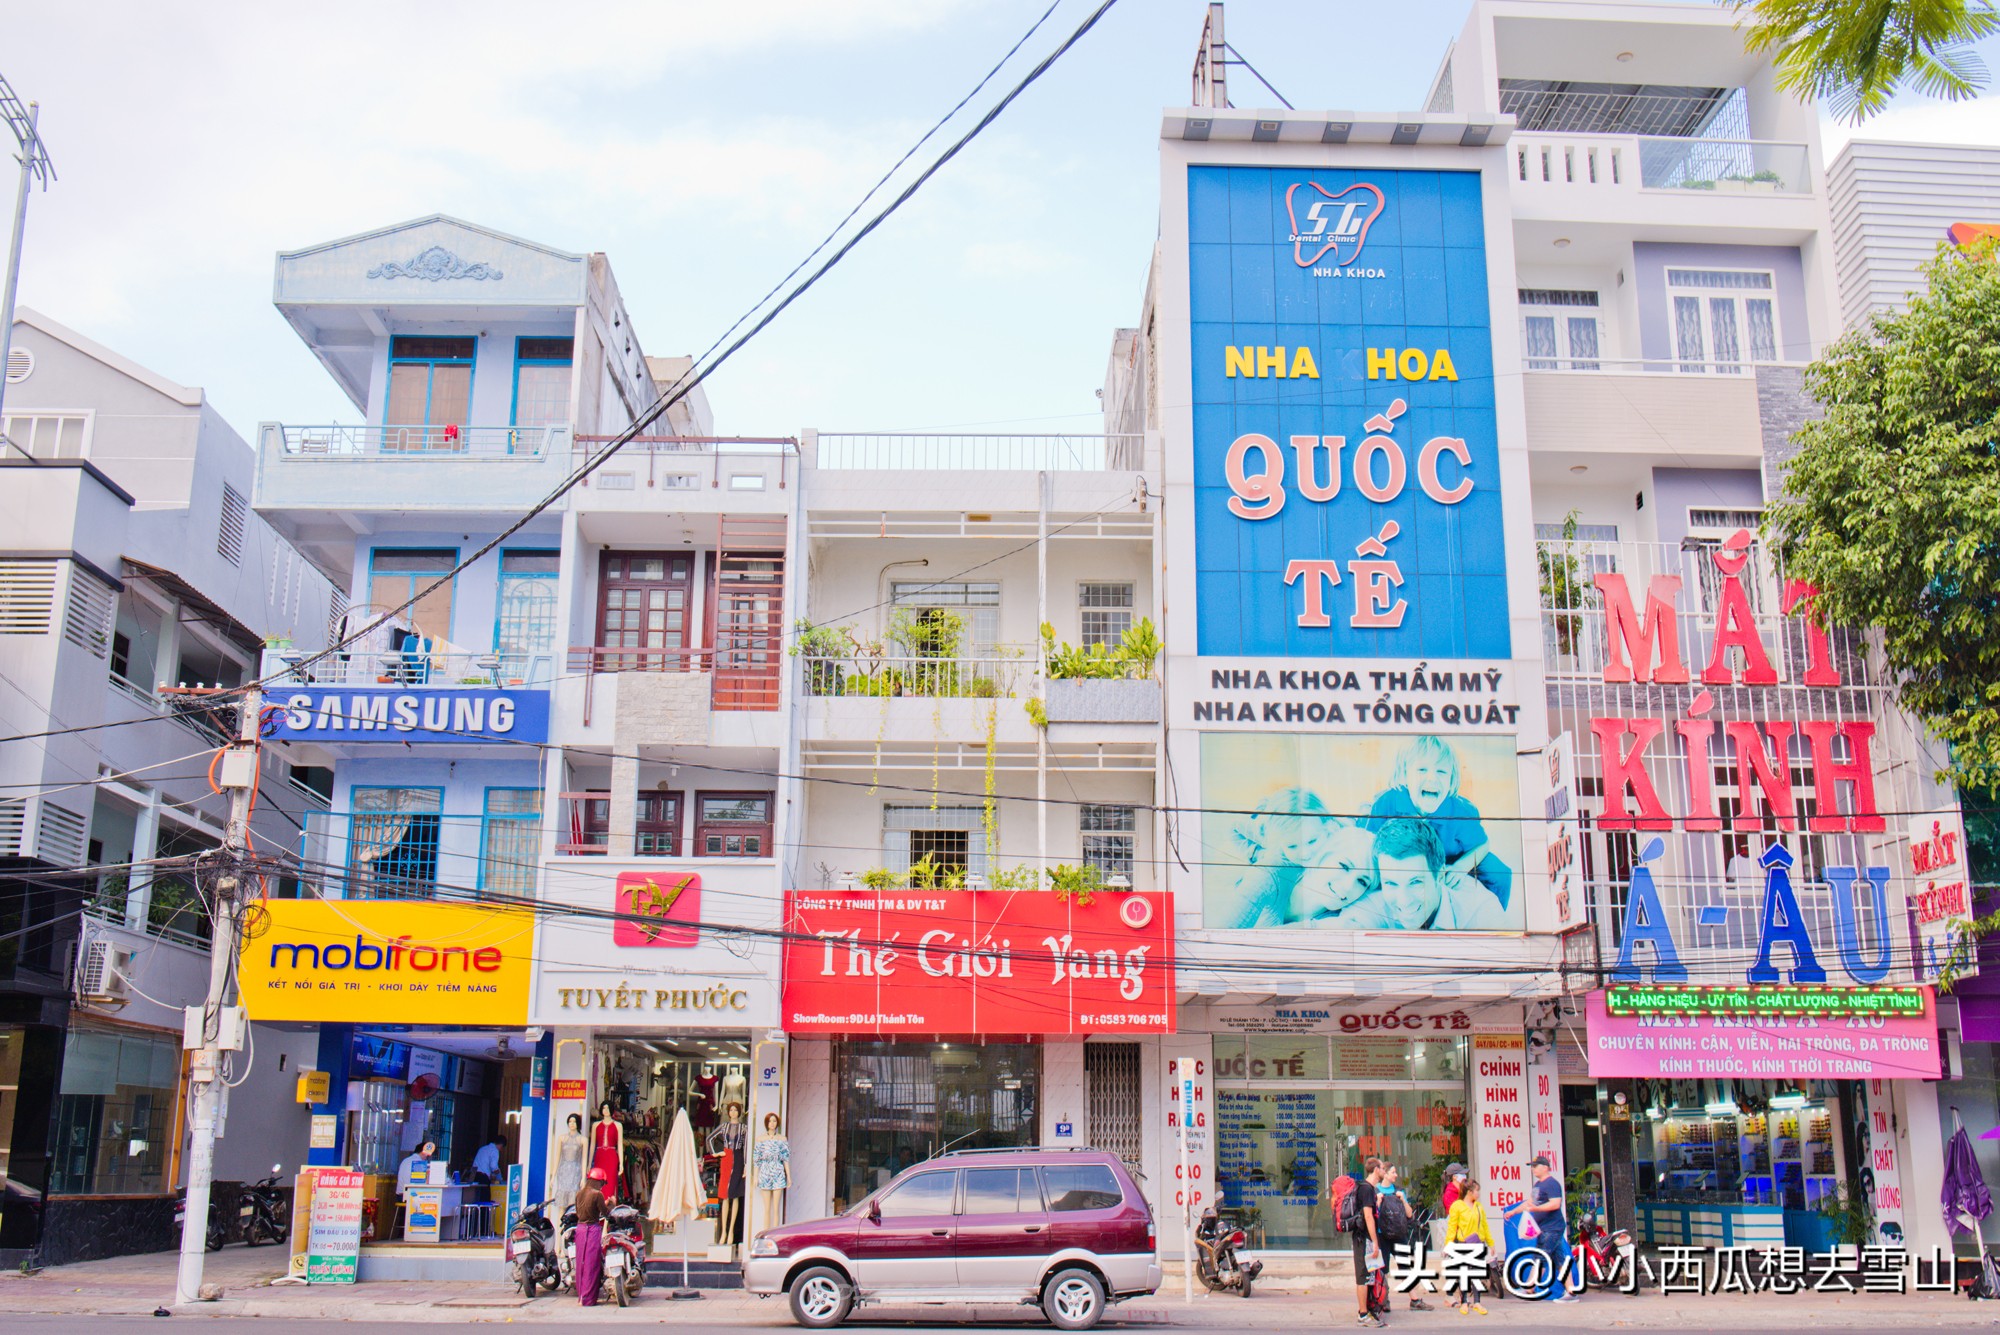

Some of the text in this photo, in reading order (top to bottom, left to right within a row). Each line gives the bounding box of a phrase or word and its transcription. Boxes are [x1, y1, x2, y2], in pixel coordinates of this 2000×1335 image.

[1288, 234, 1357, 243] Dental Clinic
[1313, 267, 1386, 278] NHA KHOA
[1225, 346, 1320, 379] NHA
[1225, 398, 1475, 520] QUỐC
[1283, 520, 1409, 628] TẾ
[1211, 662, 1503, 693] NHA KHOA THẨM MỸ
[287, 694, 516, 732] SAMSUNG
[1193, 693, 1521, 725] NHA KHOA TỔNG QUÁT
[1590, 690, 1887, 834] KÍNH
[1910, 820, 1957, 876] MẮT
[795, 897, 946, 911] CÔNG TY TNHH TM & DV T&T
[1609, 836, 1689, 984] Á
[1747, 842, 1891, 984] ÂU
[1916, 881, 1967, 925] KÍNH
[269, 934, 502, 972] mobifone
[815, 928, 1151, 1001] Thế Giới Yang
[268, 977, 287, 989] KẾT
[294, 978, 312, 990] NỐI
[319, 980, 336, 990] GIÁ
[344, 982, 360, 992] TRỊ
[558, 980, 748, 1011] TUYẾT PHƯỚC
[1630, 993, 1666, 1007] HÀNG
[1708, 994, 1725, 1007] UY
[1793, 994, 1840, 1010] LƯỢNG
[1849, 993, 1886, 1010] NHIỆT
[1887, 993, 1917, 1008] TÌNH
[863, 1013, 876, 1025] Lê
[876, 1013, 905, 1025] Thánh
[907, 1013, 924, 1025] Tôn
[1128, 1014, 1147, 1025] 706
[1148, 1014, 1167, 1026] 705
[1275, 1010, 1330, 1018] NHA KHOA
[1339, 1006, 1423, 1033] QUỐC
[1599, 1032, 1929, 1053] CHUYÊN KÍNH: CẬN, VIỄN, HAI TRÒNG, ĐA TRÒNG
[1169, 1060, 1204, 1075] PC
[1272, 1051, 1306, 1077] TẾ
[1480, 1055, 1521, 1076] CHỈNH
[1659, 1054, 1872, 1075] KÍNH THUỐC, KÍNH THỜI TRANG
[557, 1081, 581, 1089] TUYỂN
[1171, 1087, 1203, 1101] HH
[1486, 1085, 1518, 1102] HÌNH
[1538, 1074, 1550, 1096] ĐO
[1168, 1113, 1205, 1127] RG
[1483, 1109, 1521, 1128] RĂNG
[1537, 1103, 1553, 1133] MẮT
[1874, 1107, 1887, 1133] TÍN
[1496, 1135, 1514, 1154] HÔ
[1874, 1141, 1893, 1171] CHẤT
[1876, 1184, 1901, 1213] LƯỢNG
